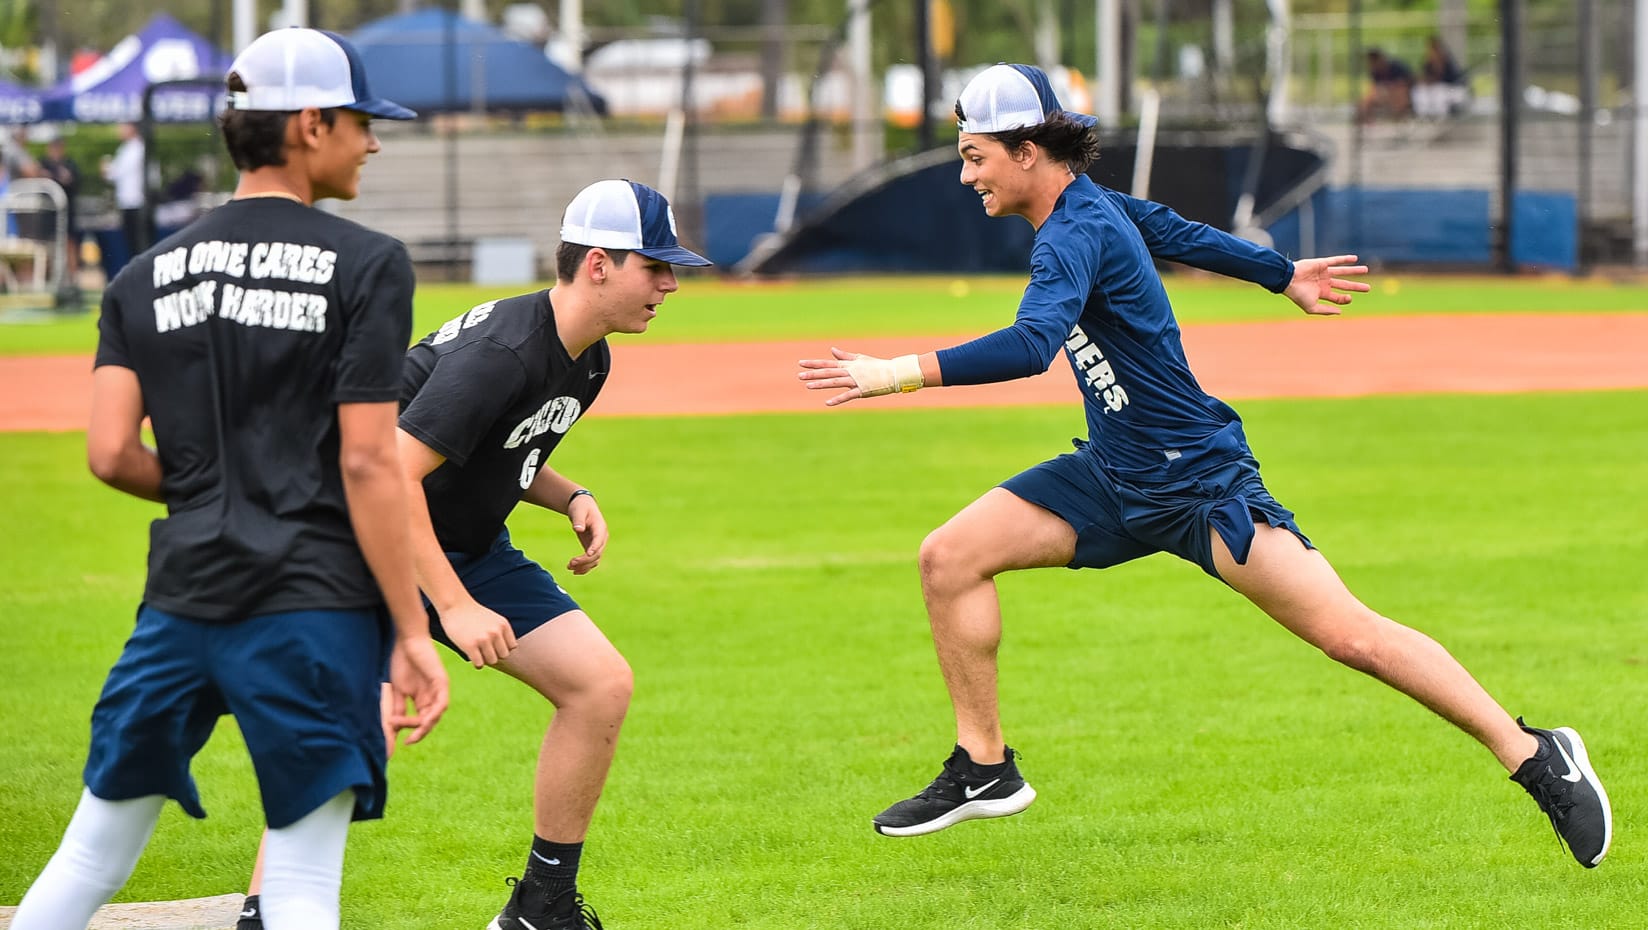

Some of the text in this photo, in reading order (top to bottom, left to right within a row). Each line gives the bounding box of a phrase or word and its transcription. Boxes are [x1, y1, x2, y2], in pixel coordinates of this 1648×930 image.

[153, 240, 338, 288] NO ONE CARES
[219, 283, 329, 333] HARDER
